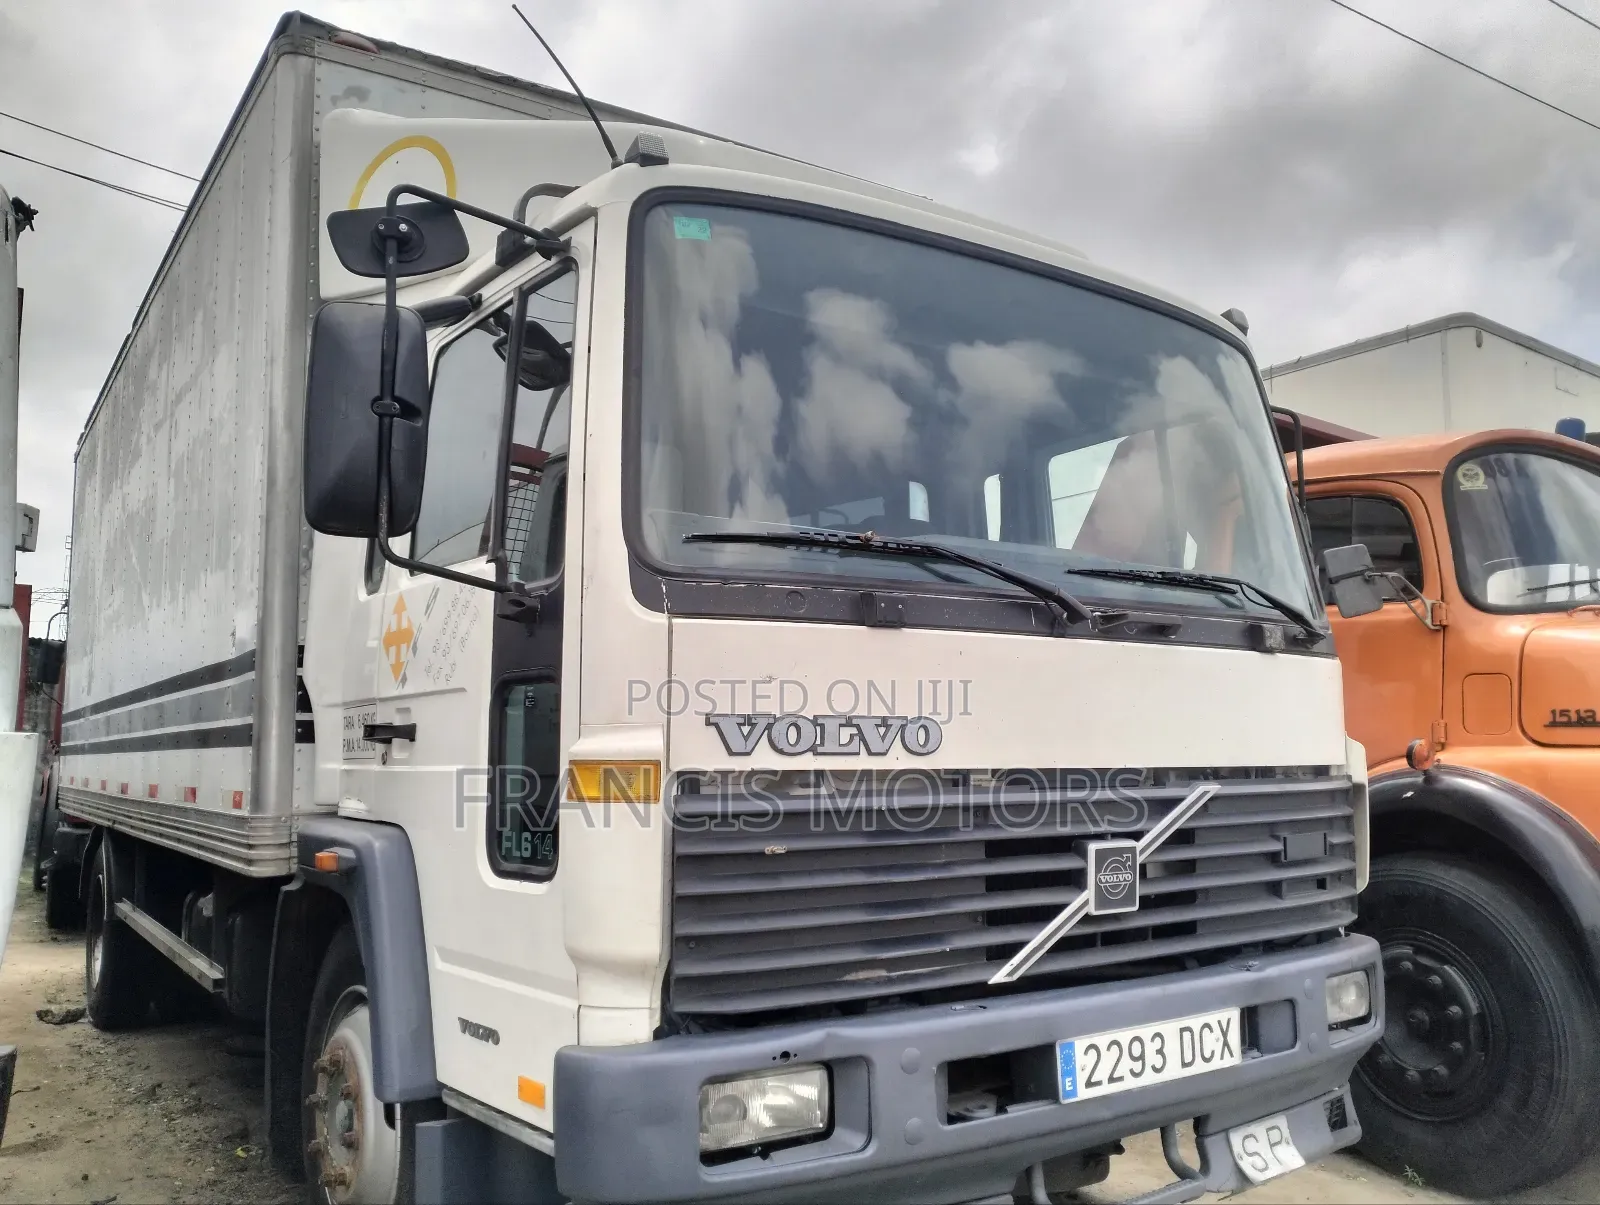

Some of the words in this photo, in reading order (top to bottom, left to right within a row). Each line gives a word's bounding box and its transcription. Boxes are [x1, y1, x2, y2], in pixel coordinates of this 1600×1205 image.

[705, 713, 943, 756] VOLVO
[1099, 873, 1132, 883] VOLVO
[457, 1016, 501, 1046] VOLVO
[1065, 1077, 1073, 1091] E
[1083, 1031, 1167, 1089] 2293
[1179, 1017, 1236, 1069] DCX
